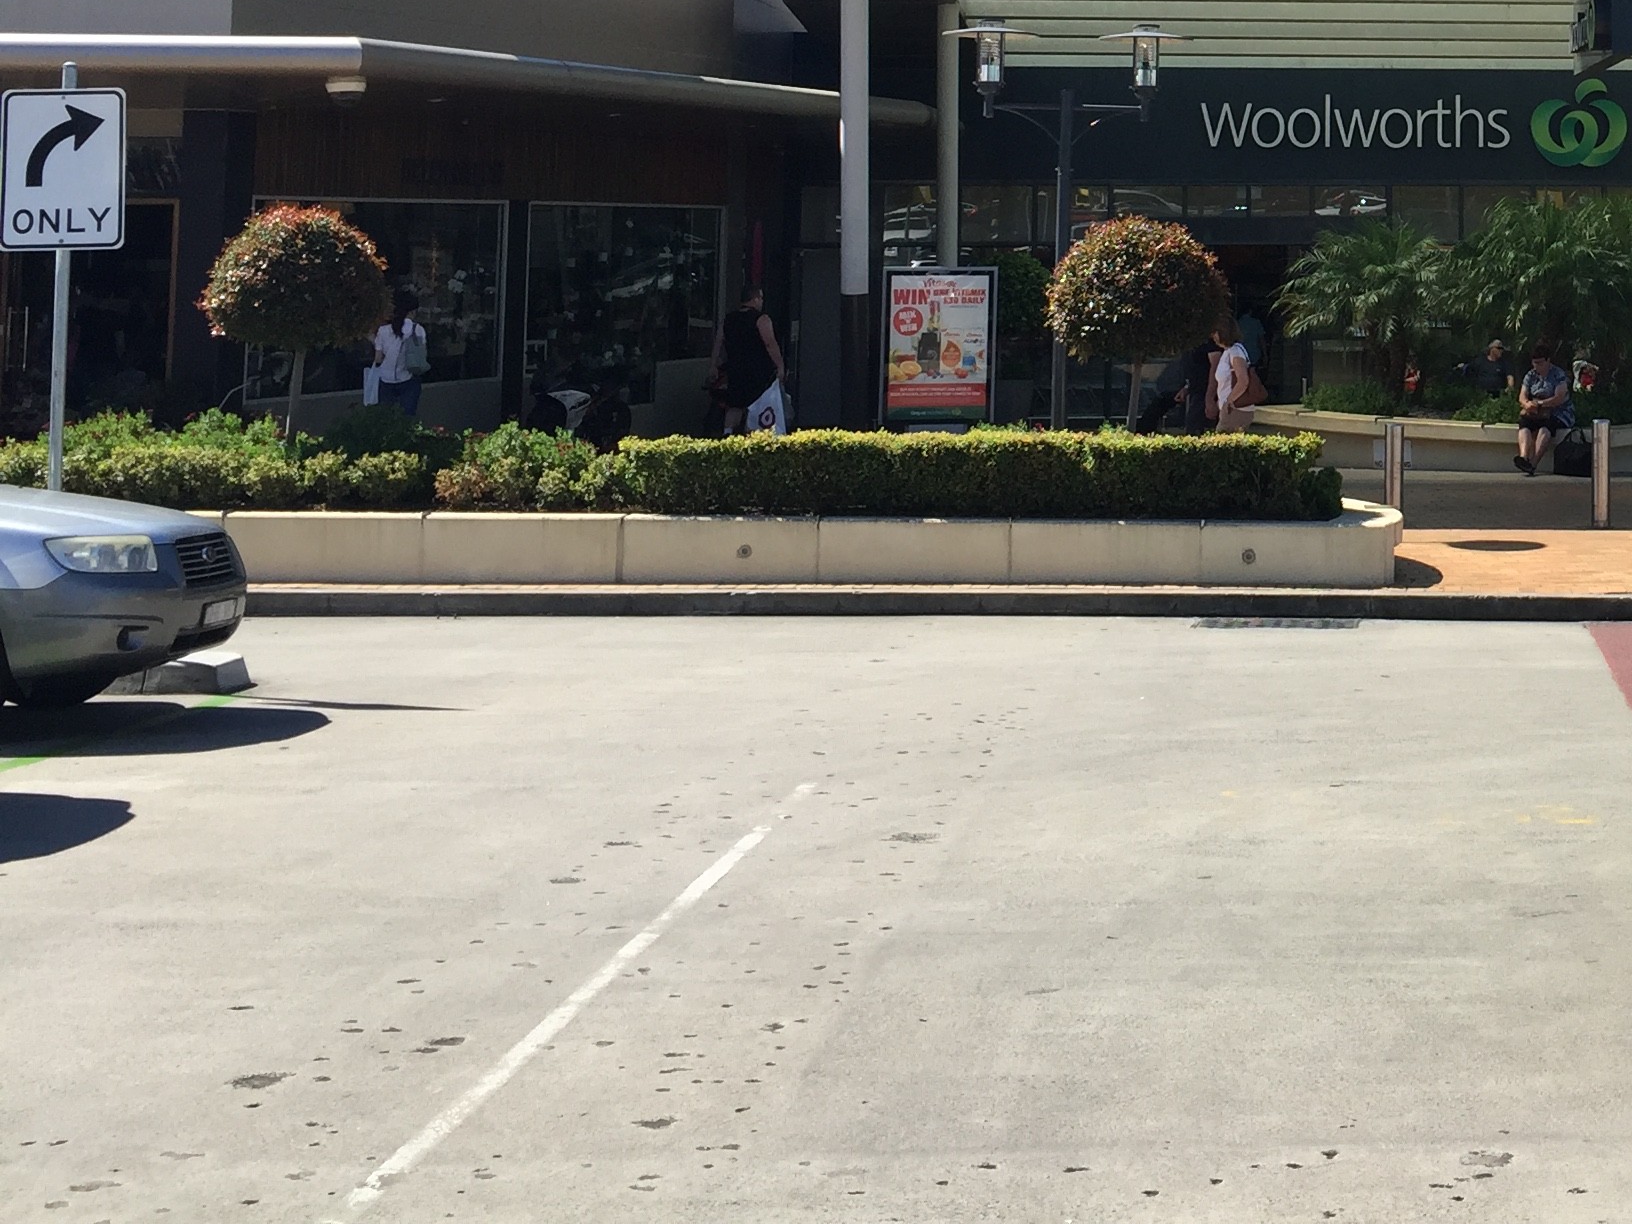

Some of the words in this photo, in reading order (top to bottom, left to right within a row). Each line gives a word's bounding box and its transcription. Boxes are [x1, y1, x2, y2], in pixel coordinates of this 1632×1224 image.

[1200, 93, 1511, 149] Woolworths
[12, 206, 112, 235] ONLY
[893, 288, 930, 305] WIN
